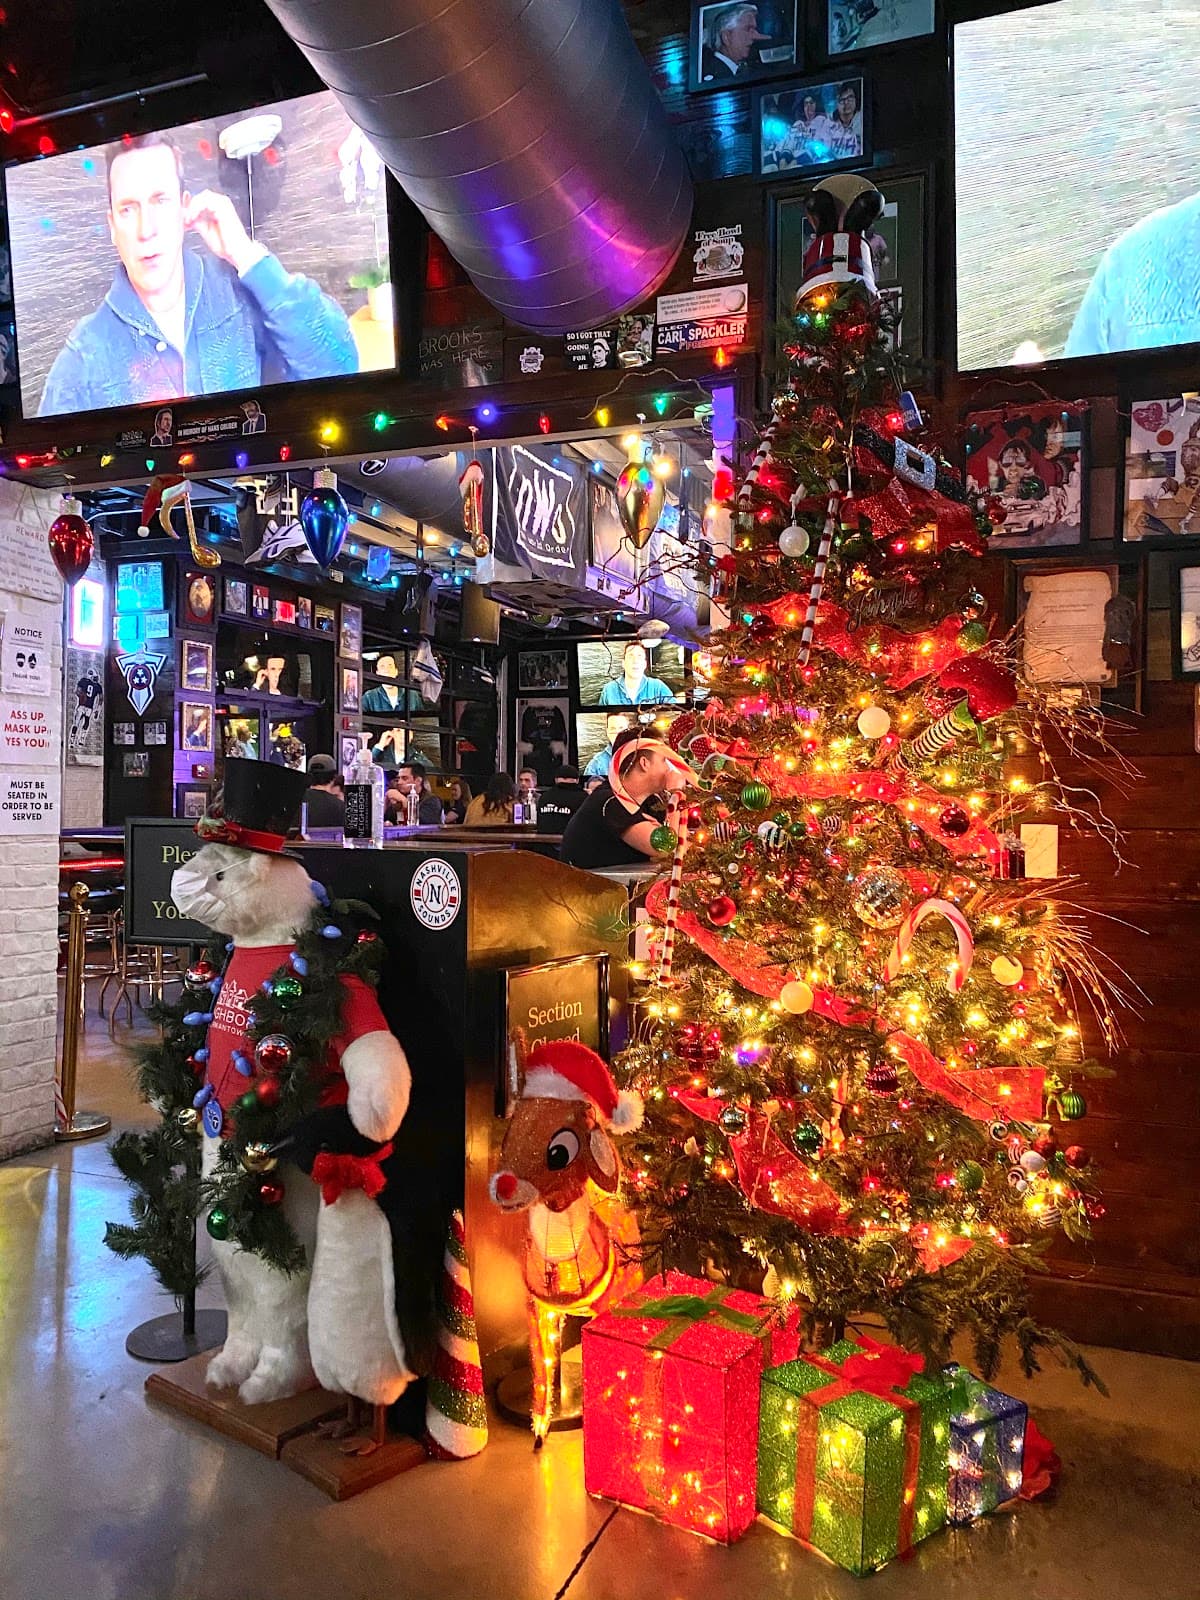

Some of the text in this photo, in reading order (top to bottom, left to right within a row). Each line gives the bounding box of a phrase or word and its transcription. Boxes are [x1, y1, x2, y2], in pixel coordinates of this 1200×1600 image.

[658, 323, 690, 332] ELECT
[566, 332, 575, 340] SO
[580, 331, 593, 339] GOT
[594, 330, 611, 339] THAT
[657, 322, 745, 345] CARL SPACKLER
[418, 326, 482, 358] BROOKS
[567, 343, 589, 351] GOING
[420, 345, 487, 372] WAS HERE
[16, 525, 45, 543] REWARD
[14, 627, 43, 639] NOTICE
[86, 684, 94, 698] 9
[10, 710, 28, 720] ASS
[4, 723, 31, 734] MASK
[6, 737, 20, 746] YES
[10, 781, 45, 789] MUST BE
[7, 791, 48, 800] SEATED IN
[2, 802, 54, 810] ORDER TO BE
[12, 812, 42, 821] SERVED
[415, 864, 457, 893] NASHVILLE
[417, 904, 451, 924] SOUNDS
[527, 1001, 583, 1028] Section
